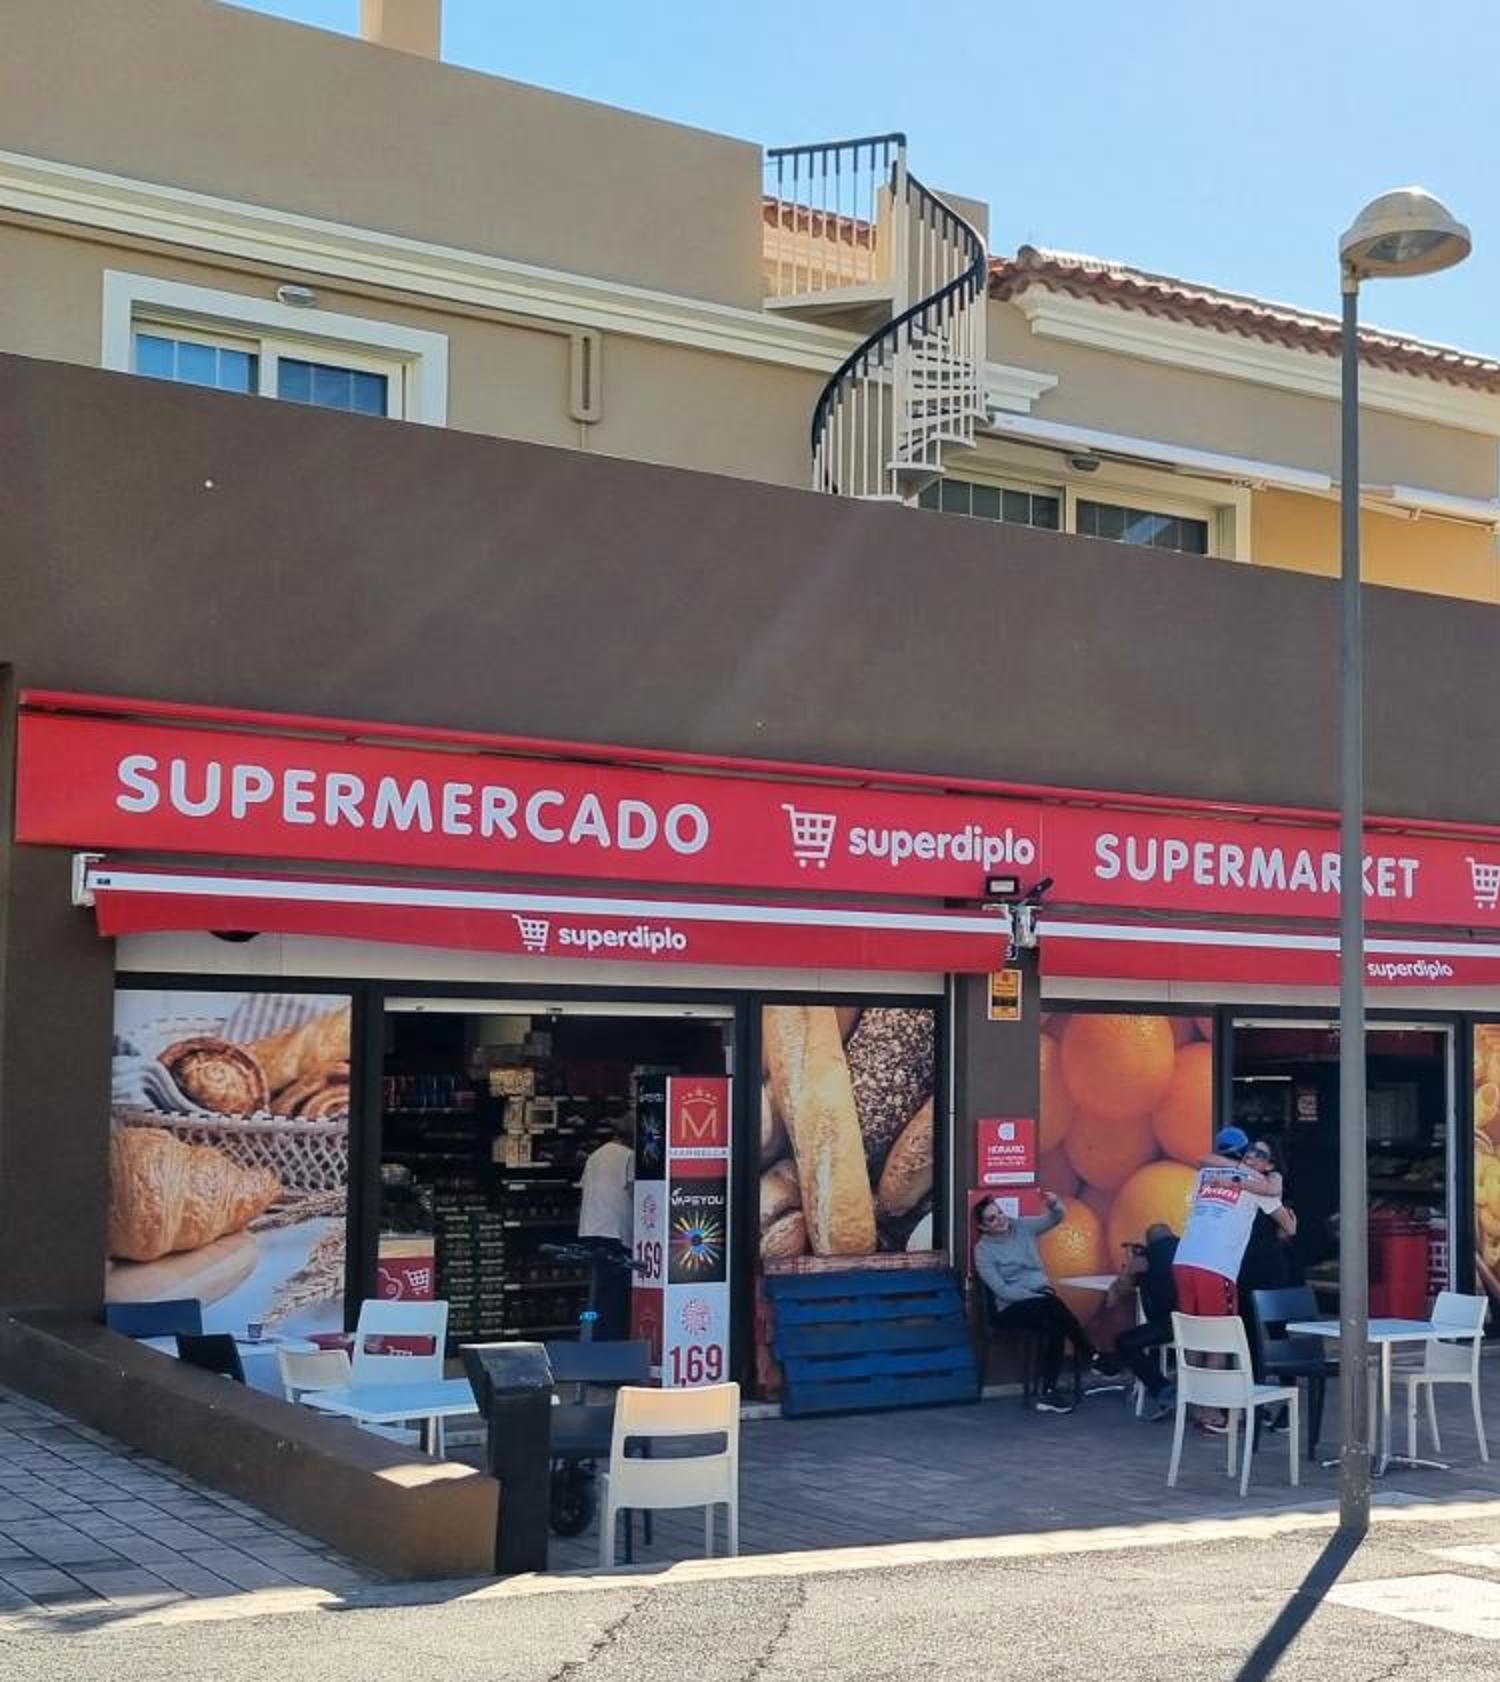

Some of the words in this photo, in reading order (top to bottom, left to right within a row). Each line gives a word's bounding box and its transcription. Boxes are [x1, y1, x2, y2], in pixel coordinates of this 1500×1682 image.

[116, 755, 710, 855] SUPERMERCADO
[848, 826, 1035, 872] superdiplo
[1094, 833, 1420, 898] SUPERMARKET
[558, 925, 688, 953] superdiplo
[1367, 959, 1453, 980] superdiplo
[682, 1107, 717, 1139] M
[669, 1345, 723, 1387] 1,69
